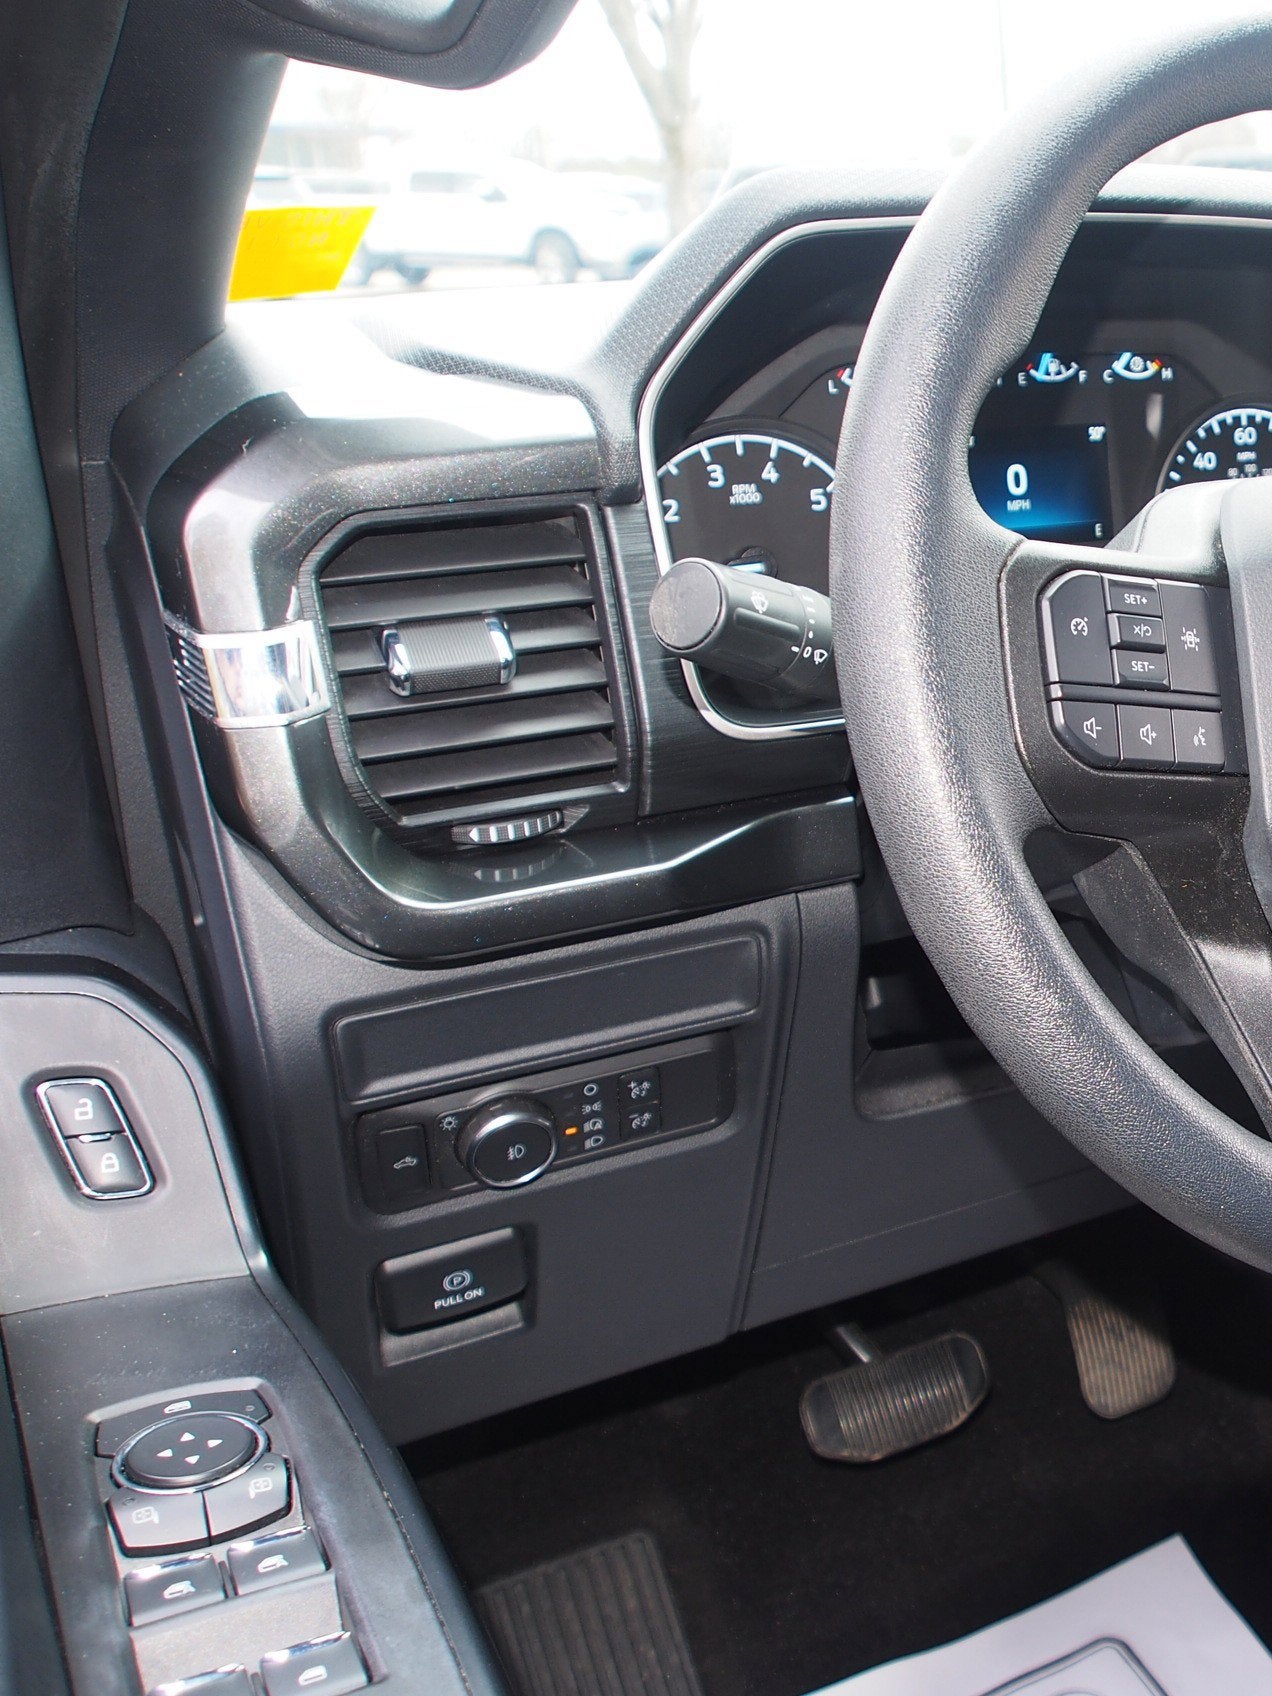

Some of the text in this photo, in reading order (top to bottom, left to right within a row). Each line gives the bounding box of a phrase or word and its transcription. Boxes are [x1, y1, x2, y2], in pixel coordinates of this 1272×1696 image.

[1017, 371, 1028, 387] E
[1078, 369, 1089, 384] F
[1102, 366, 1174, 384] C H
[1233, 426, 1258, 446] 60
[1192, 451, 1218, 471] 40
[706, 464, 726, 488] 3
[761, 461, 780, 484] 4
[1006, 463, 1028, 496] 0
[731, 483, 758, 494] RPM
[810, 488, 828, 512] 5
[1006, 499, 1031, 512] MPH
[662, 499, 681, 523] 2
[434, 1288, 482, 1310] PULL ON
